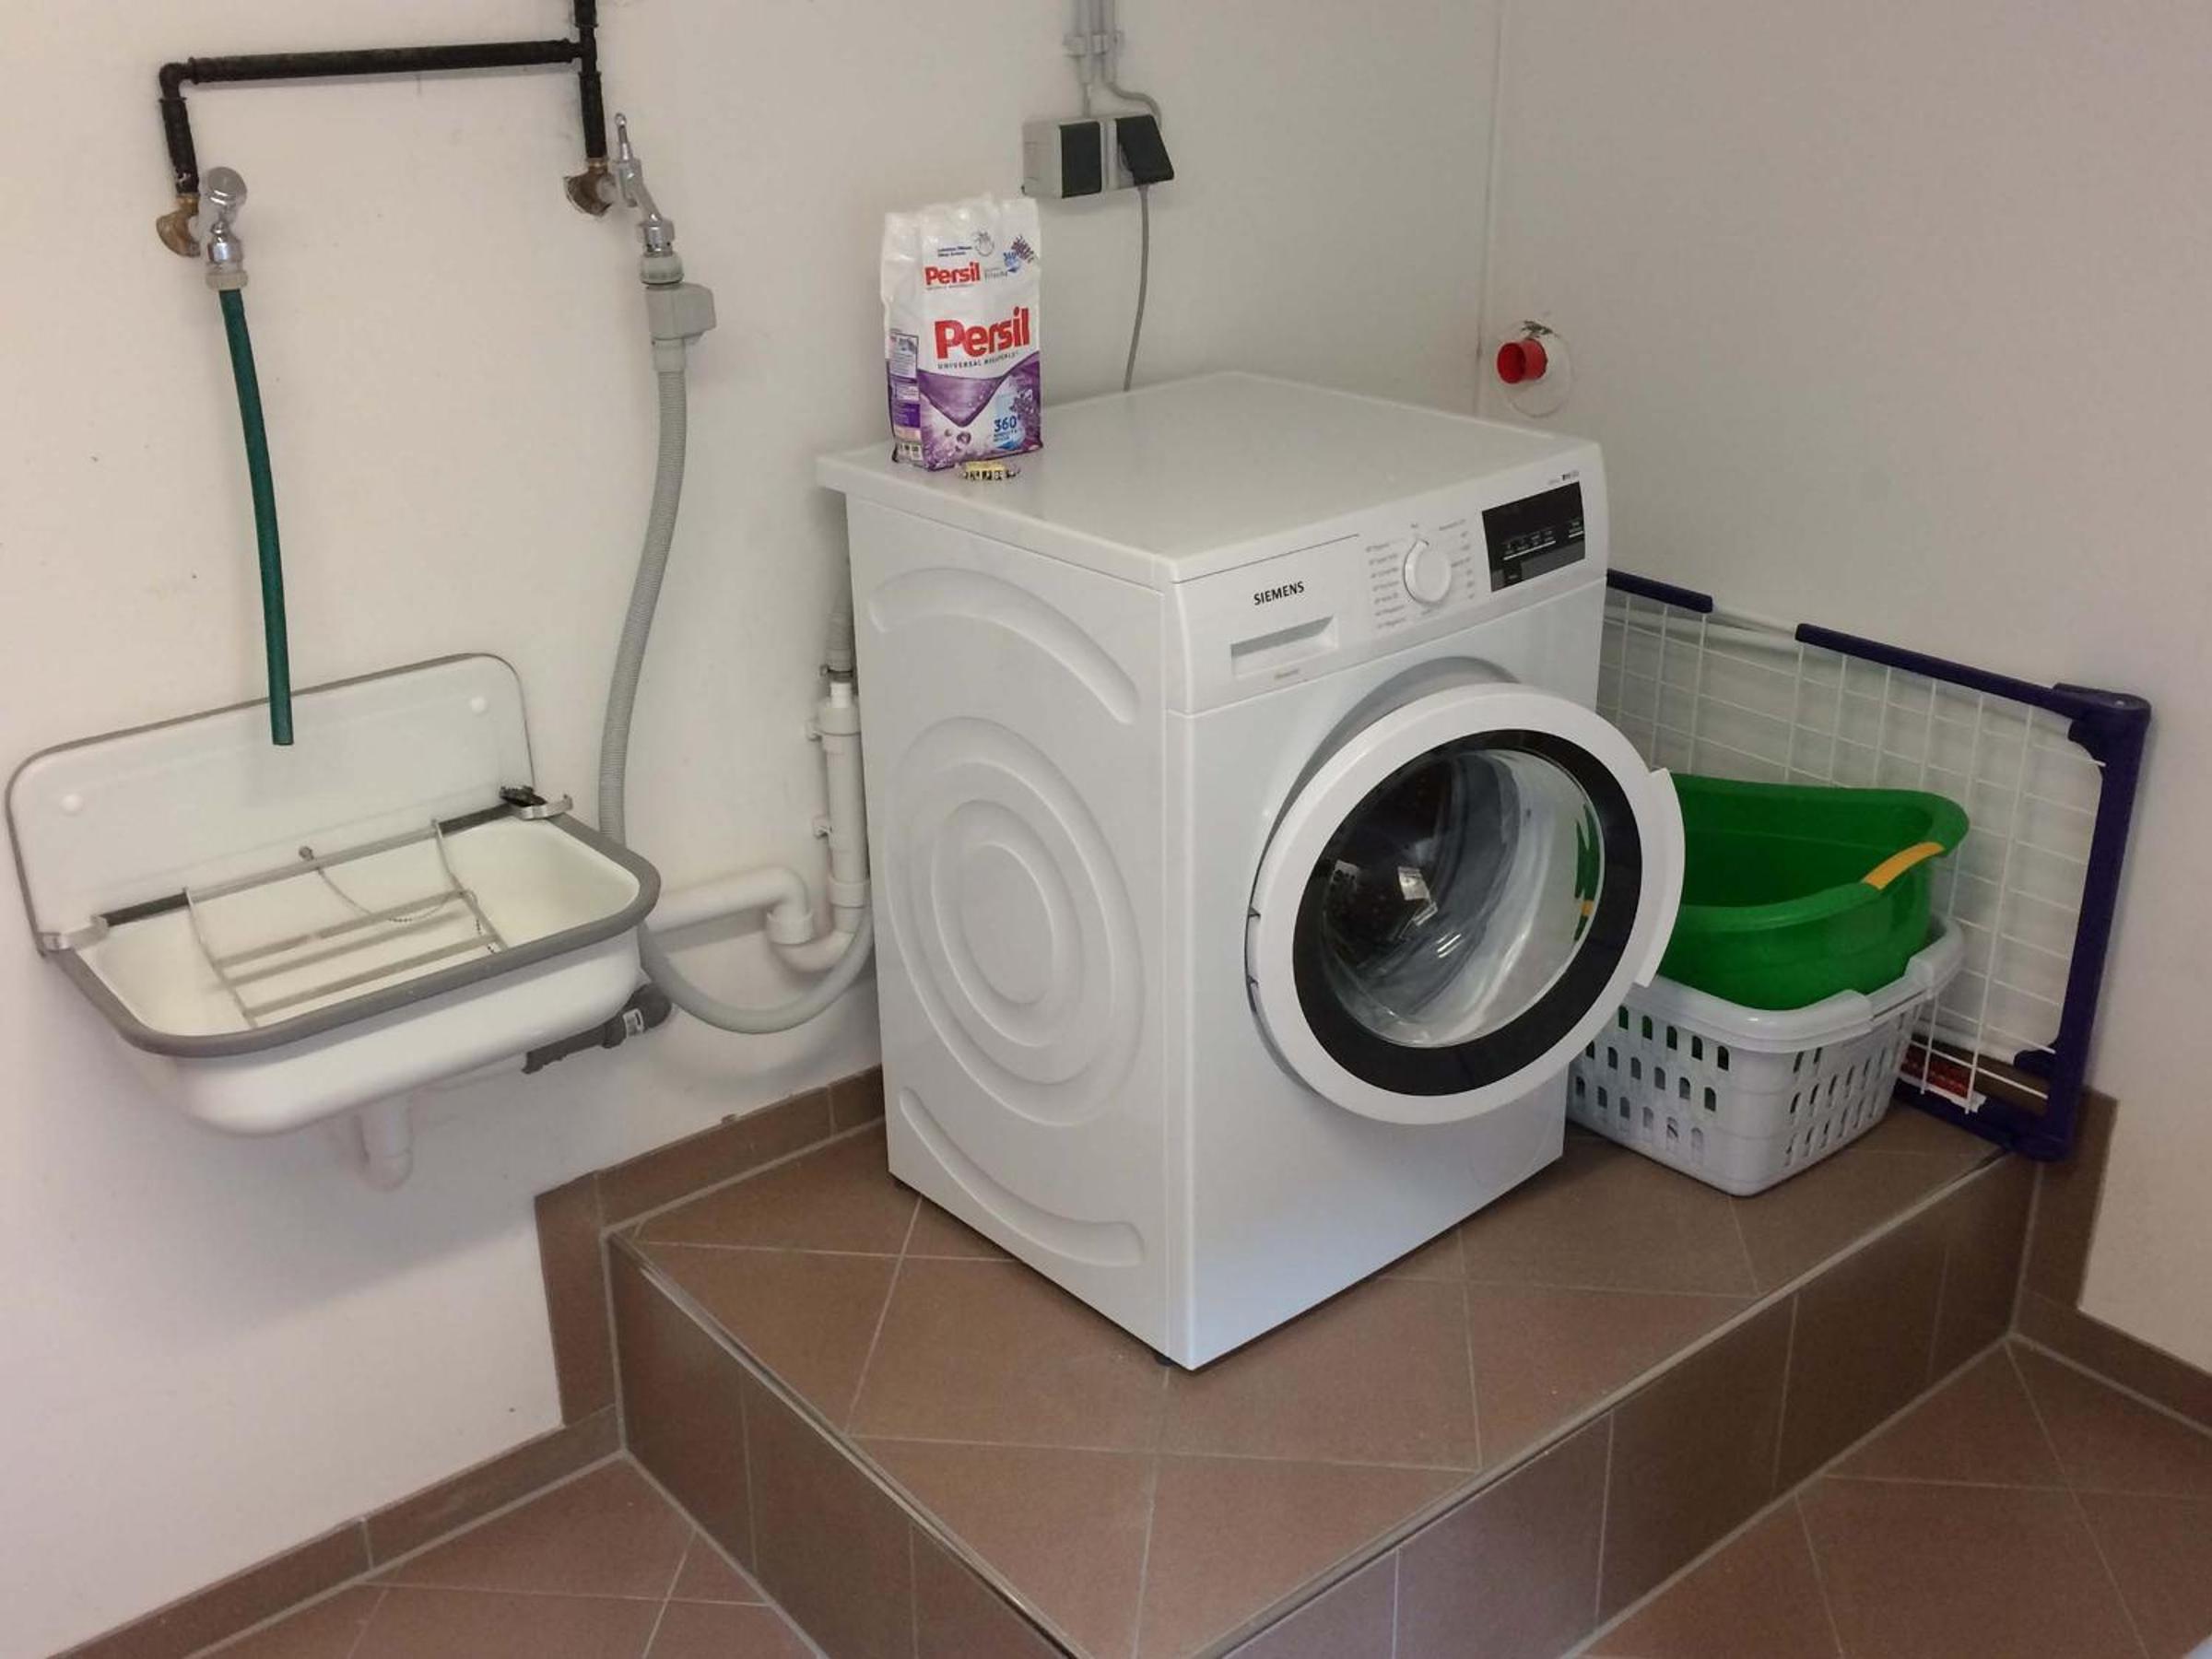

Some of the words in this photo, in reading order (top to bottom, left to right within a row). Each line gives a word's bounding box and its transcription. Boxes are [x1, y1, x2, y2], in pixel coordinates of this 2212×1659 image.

[924, 262, 981, 285] Persil
[935, 307, 1030, 359] Persil
[937, 359, 982, 370] UNIVERSAL
[1253, 581, 1305, 606] SIEMENS
